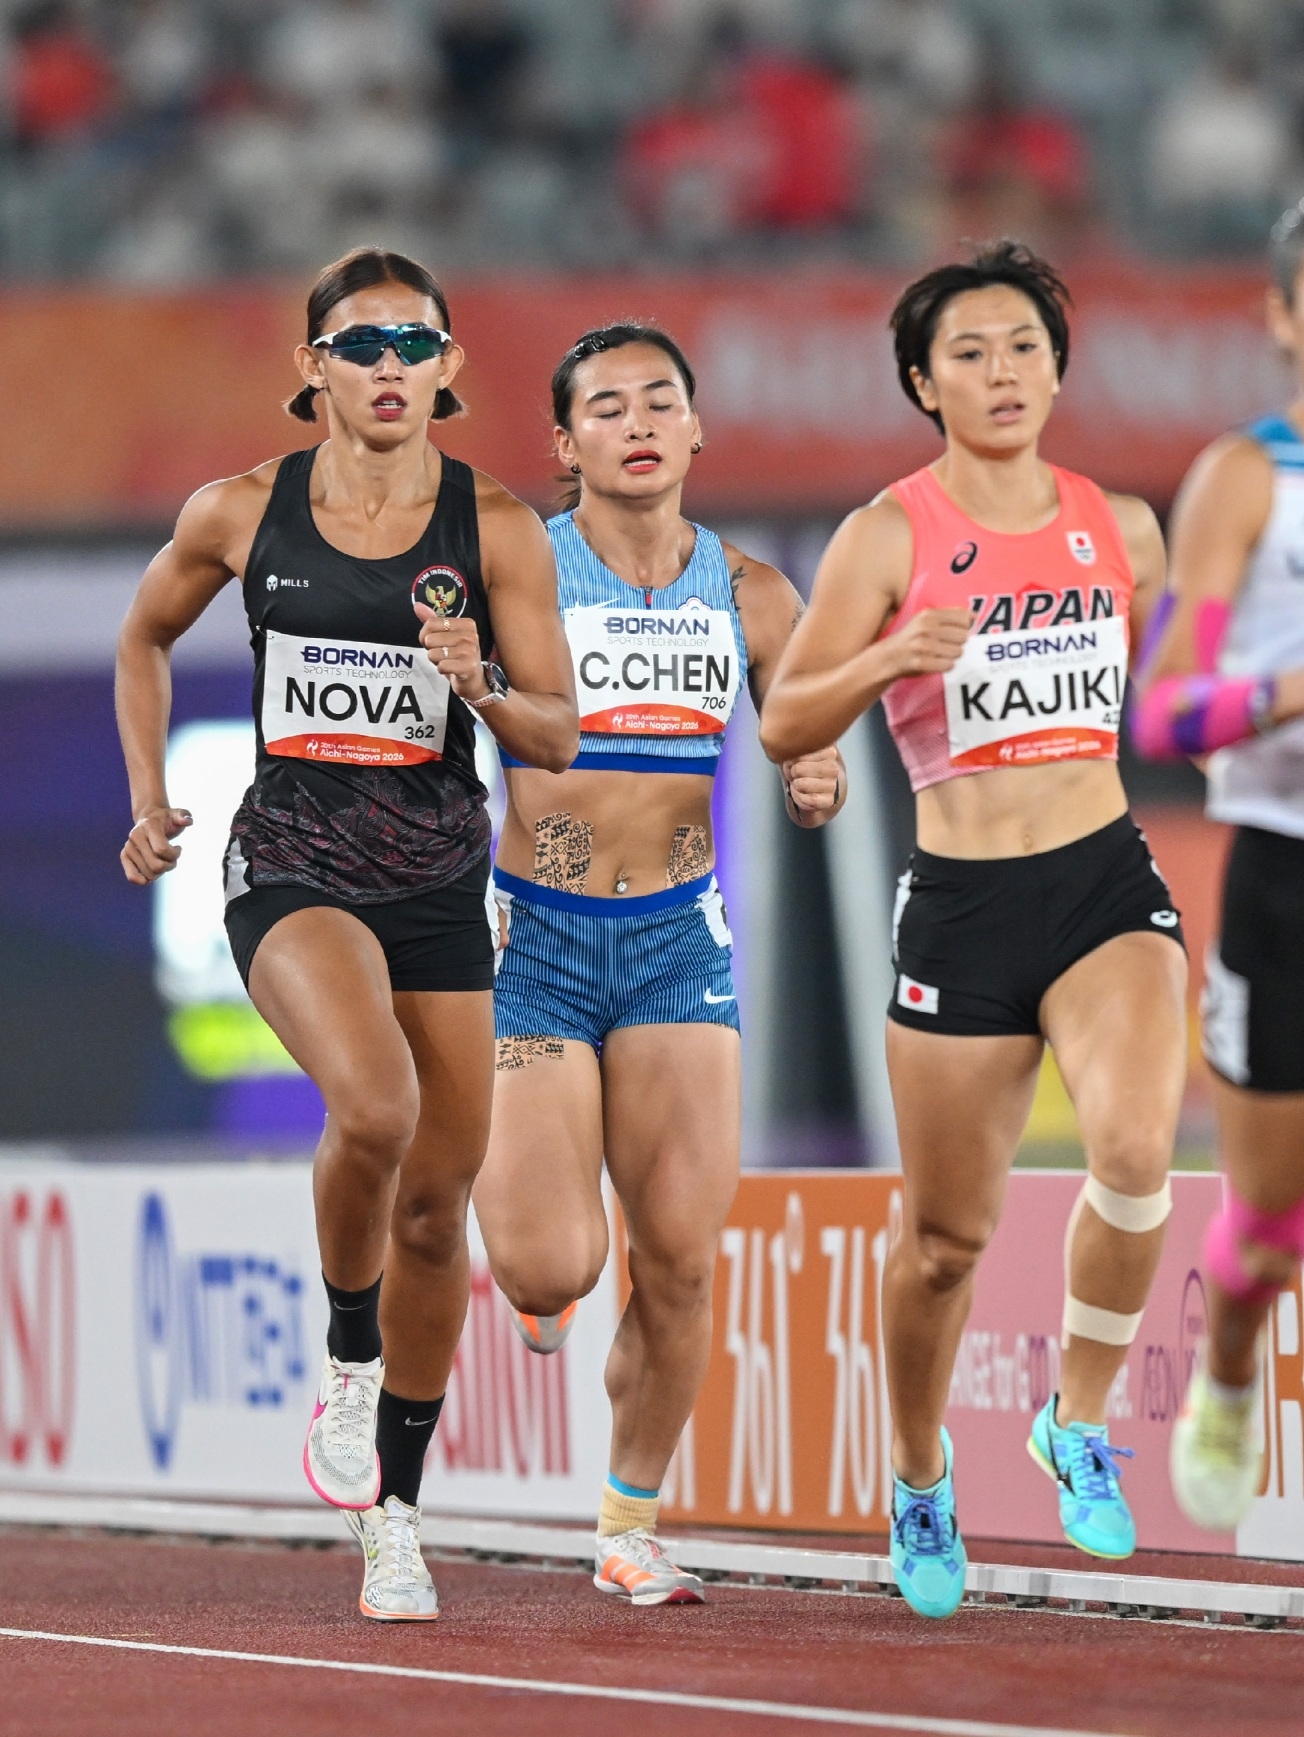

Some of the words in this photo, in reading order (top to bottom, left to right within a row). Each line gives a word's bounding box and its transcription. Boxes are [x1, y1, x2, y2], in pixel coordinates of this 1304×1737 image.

[281, 578, 309, 588] MILLS
[418, 572, 430, 584] TIM
[430, 569, 463, 588] INDONESIA
[603, 617, 709, 635] BORNAN
[607, 637, 642, 646] SPORTS
[647, 638, 709, 647] TECHNOLOGY
[985, 631, 1097, 662] BORNAN
[301, 646, 414, 669] BORNAN
[304, 666, 341, 676] SPORTS
[346, 668, 412, 679] TECHNOLOGY
[580, 651, 729, 692] C.CHEN
[285, 677, 423, 723] NOVA
[960, 665, 1120, 721] KAJIKI
[702, 696, 727, 710] 706
[404, 725, 435, 739] 362
[337, 743, 355, 751] Asian
[358, 745, 380, 753] Games
[383, 753, 404, 761] 2026
